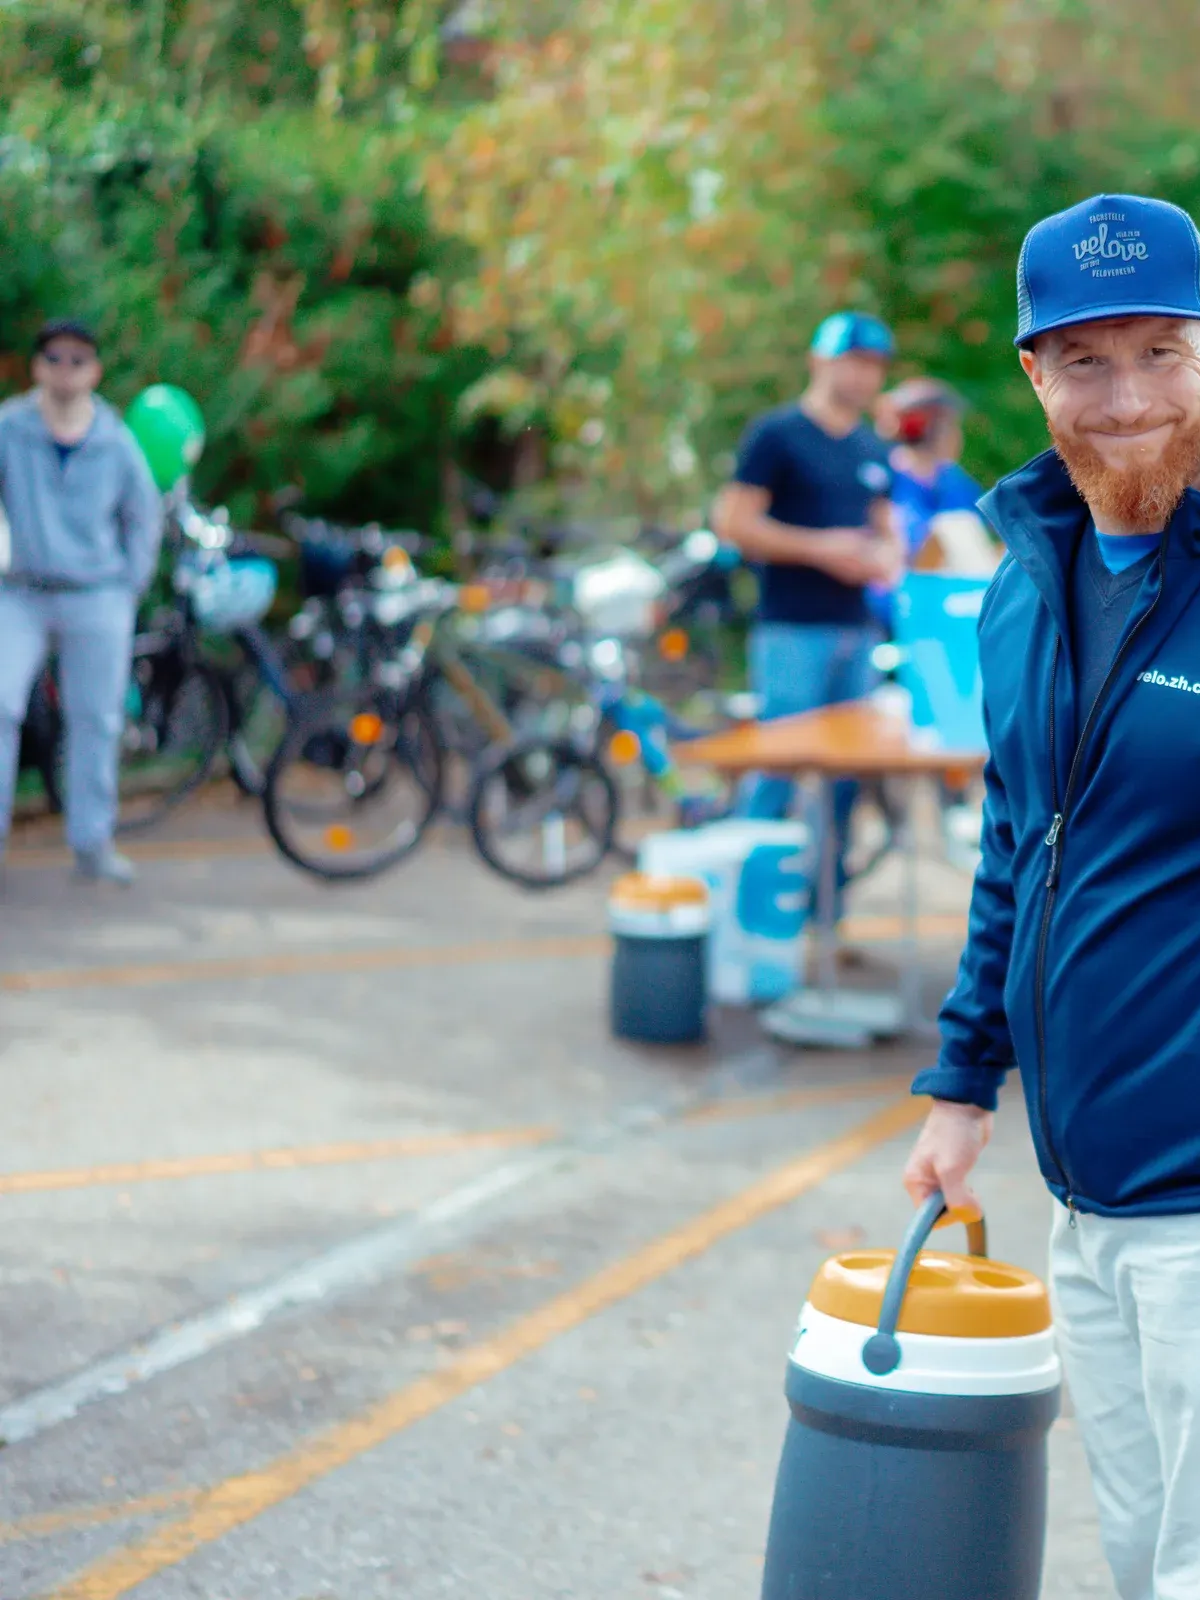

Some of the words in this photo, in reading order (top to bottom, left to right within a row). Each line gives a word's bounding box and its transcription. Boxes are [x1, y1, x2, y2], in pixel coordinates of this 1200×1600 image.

[1089, 212, 1126, 224] FACHSTELLE
[1072, 223, 1149, 261] velove
[1092, 266, 1136, 278] VELOVERKEHR
